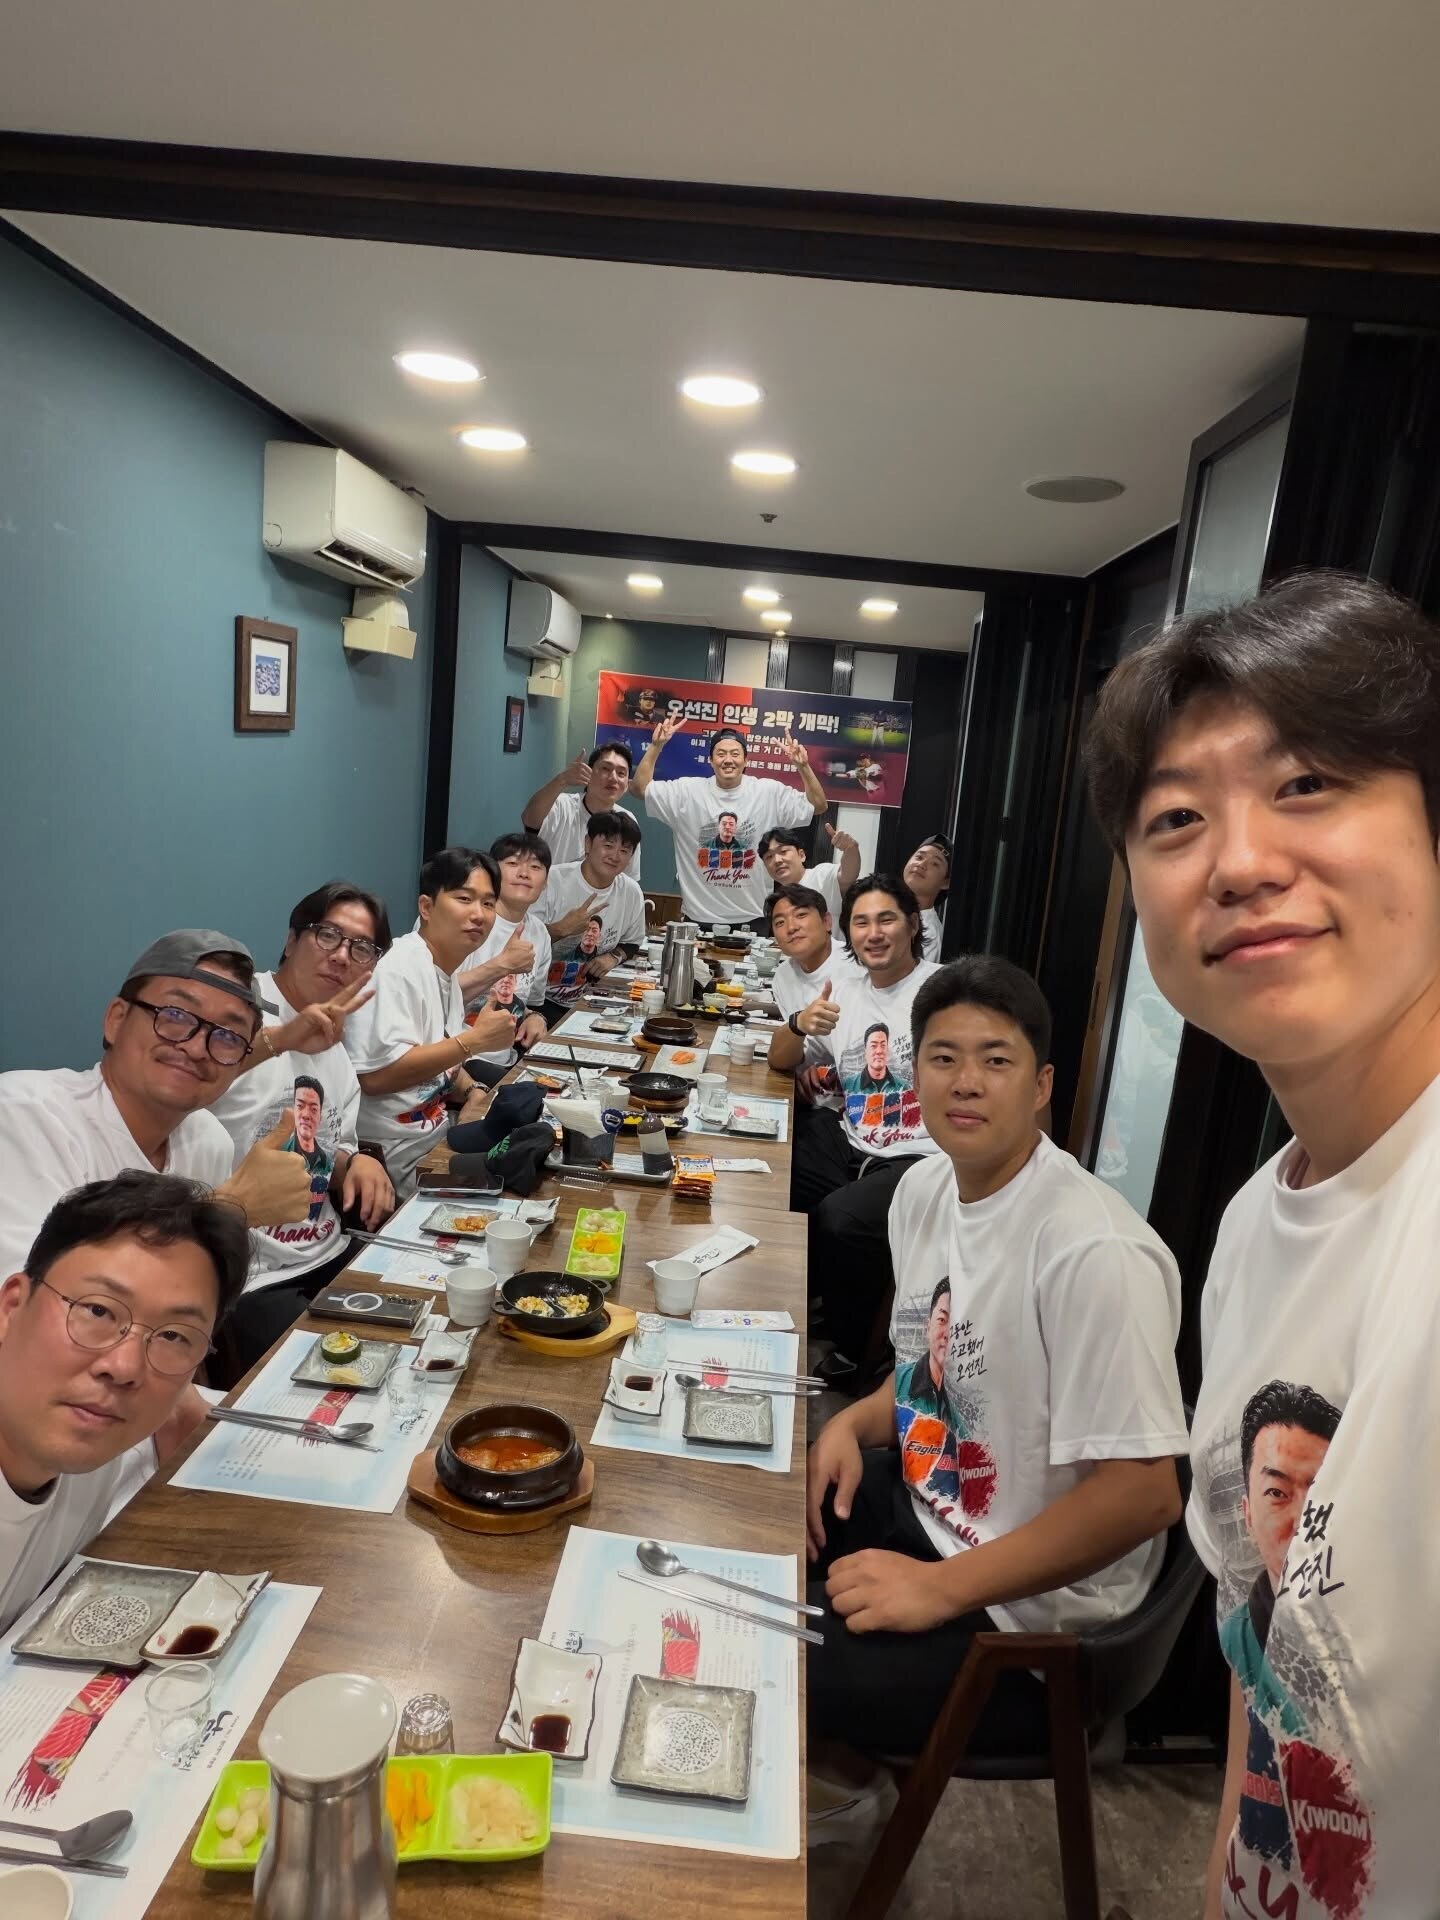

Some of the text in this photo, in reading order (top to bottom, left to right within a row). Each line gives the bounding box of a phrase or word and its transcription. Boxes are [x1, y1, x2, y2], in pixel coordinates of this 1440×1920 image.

[666, 699, 840, 734] 오선진 인생 2막 개막!
[690, 738, 706, 747] 이제
[703, 868, 732, 882] Thank
[950, 1336, 985, 1360] 수고했어
[956, 1355, 988, 1383] 오선진
[905, 1439, 943, 1456] Eagles
[959, 1464, 996, 1481] KIWOOM
[1291, 1799, 1369, 1841] KIWOOM
